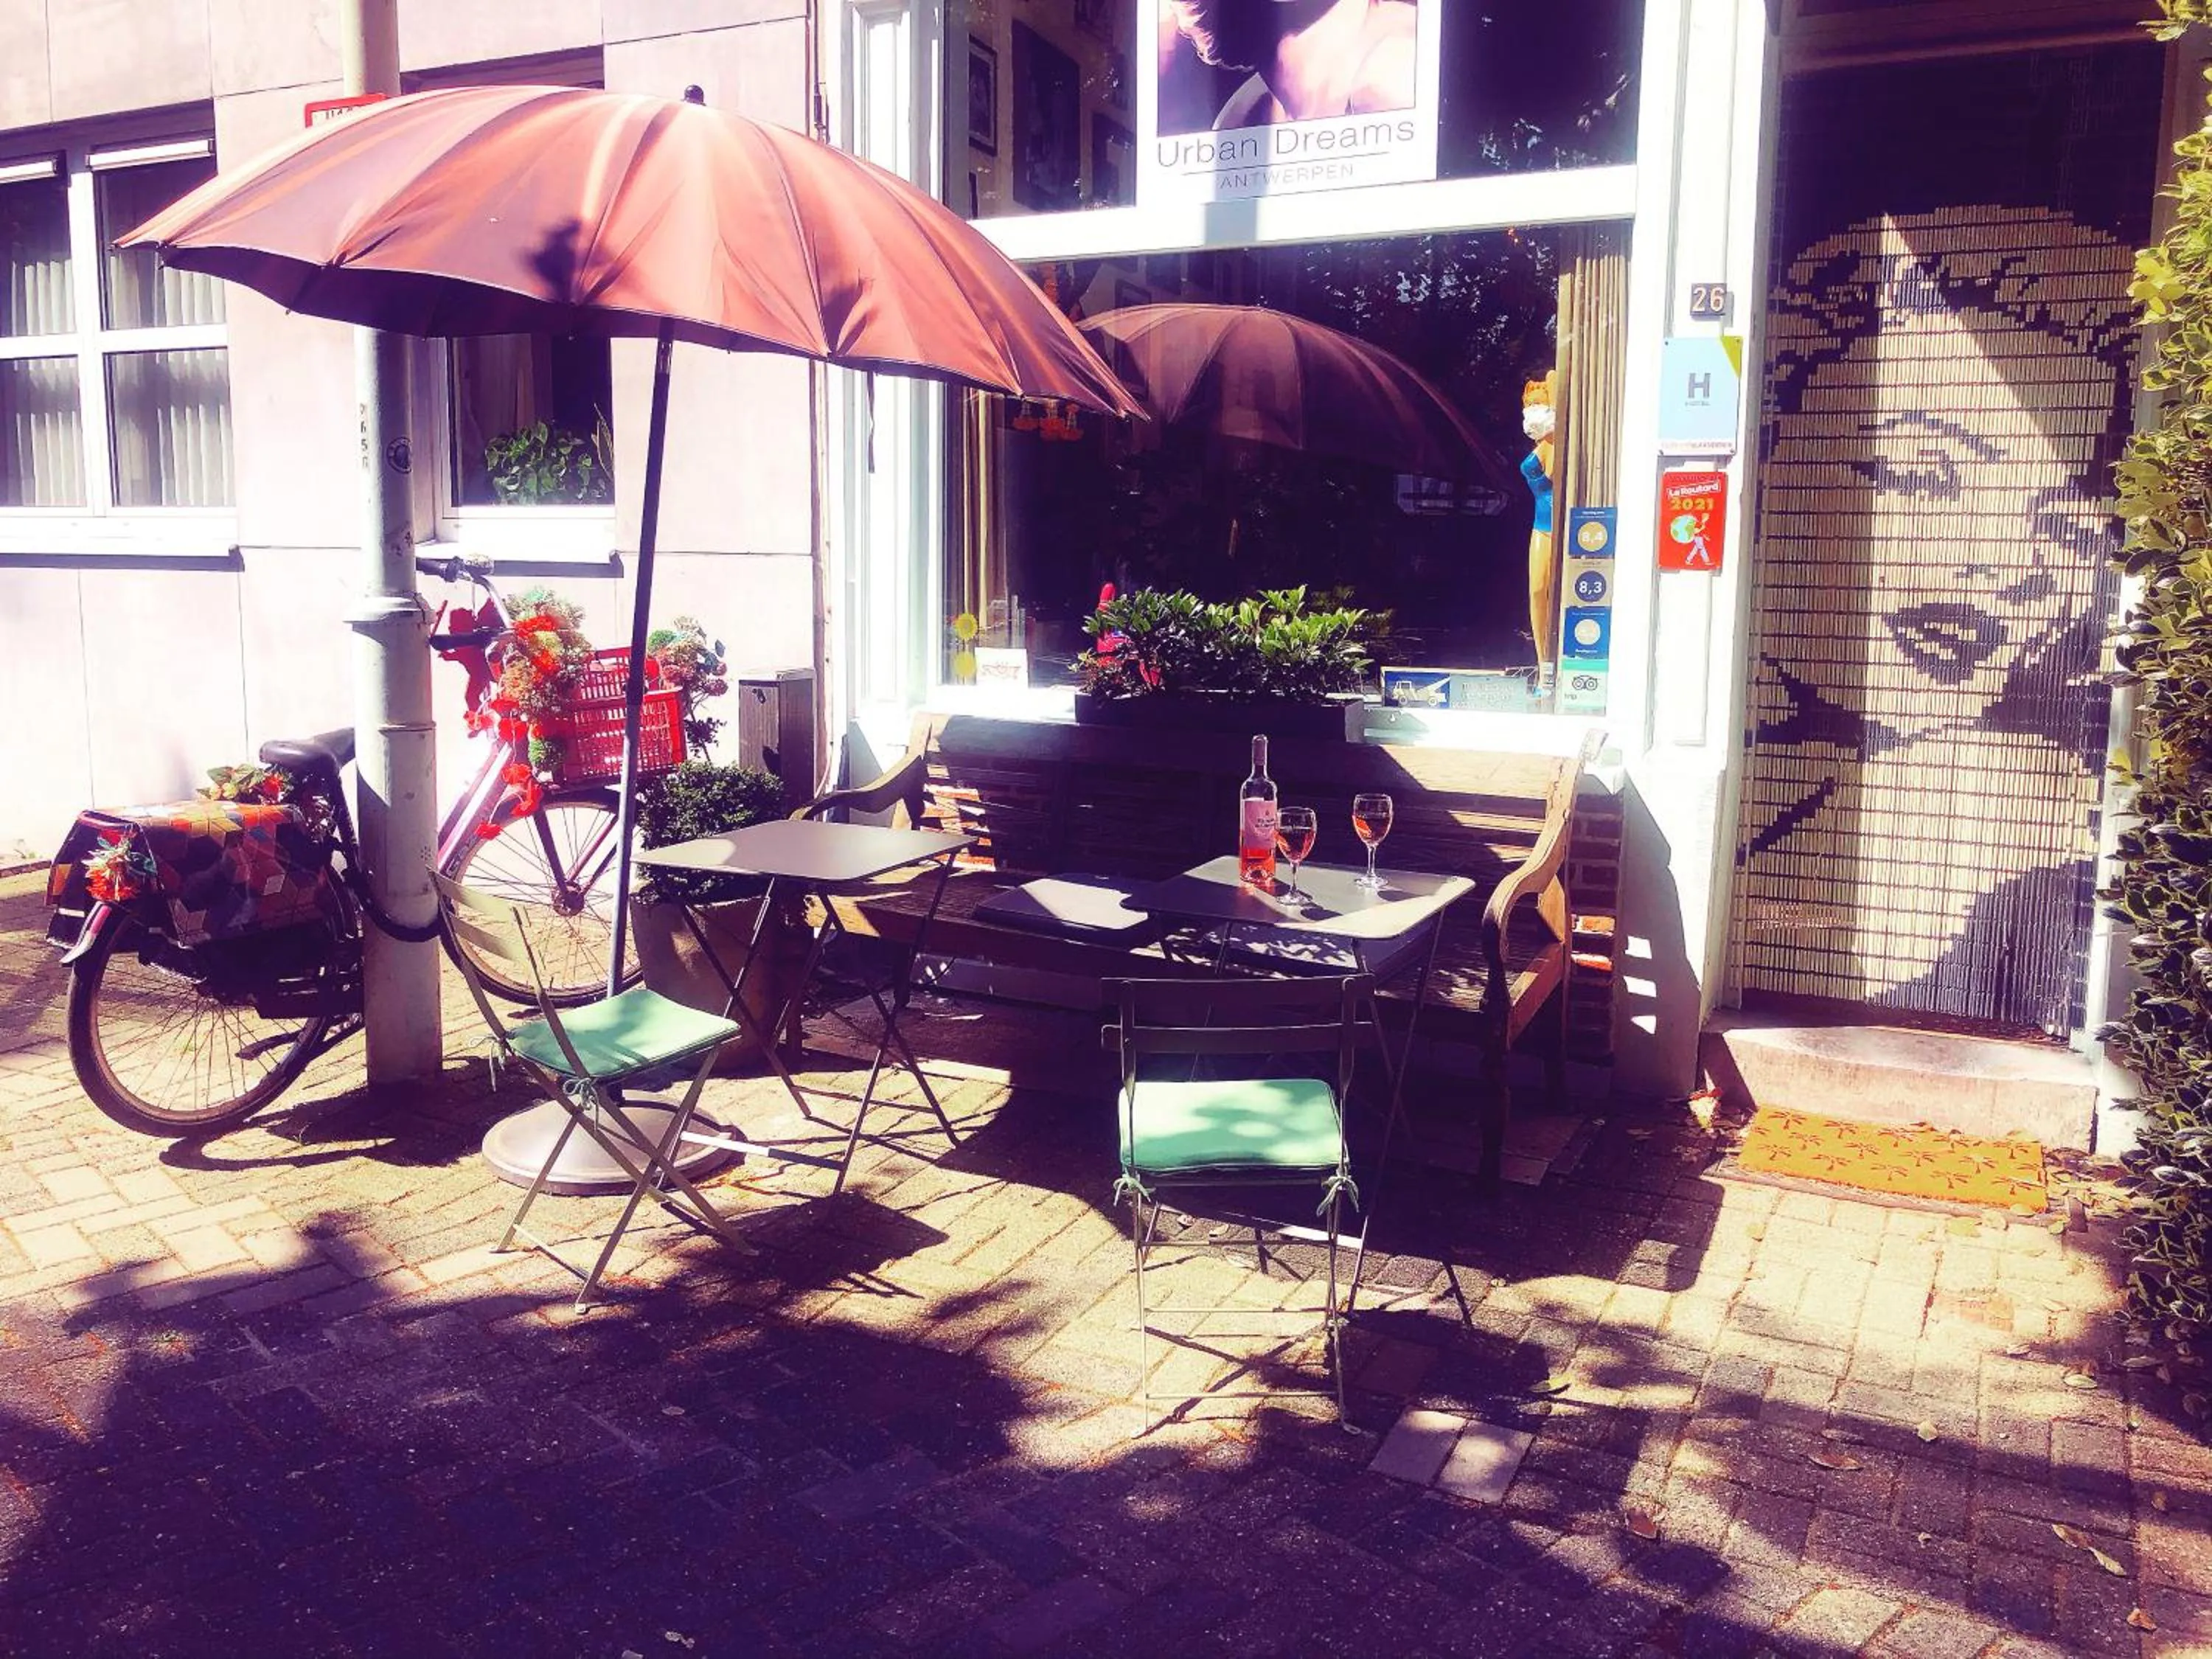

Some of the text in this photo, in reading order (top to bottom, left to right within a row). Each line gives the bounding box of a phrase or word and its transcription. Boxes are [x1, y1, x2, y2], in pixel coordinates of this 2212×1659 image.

[1157, 121, 1415, 167] Urban Dreams
[1220, 163, 1354, 189] ANTWERPEN
[1691, 287, 1725, 312] 26
[1688, 372, 1711, 398] H
[1670, 497, 1714, 511] 2021
[1579, 580, 1602, 595] 8,3
